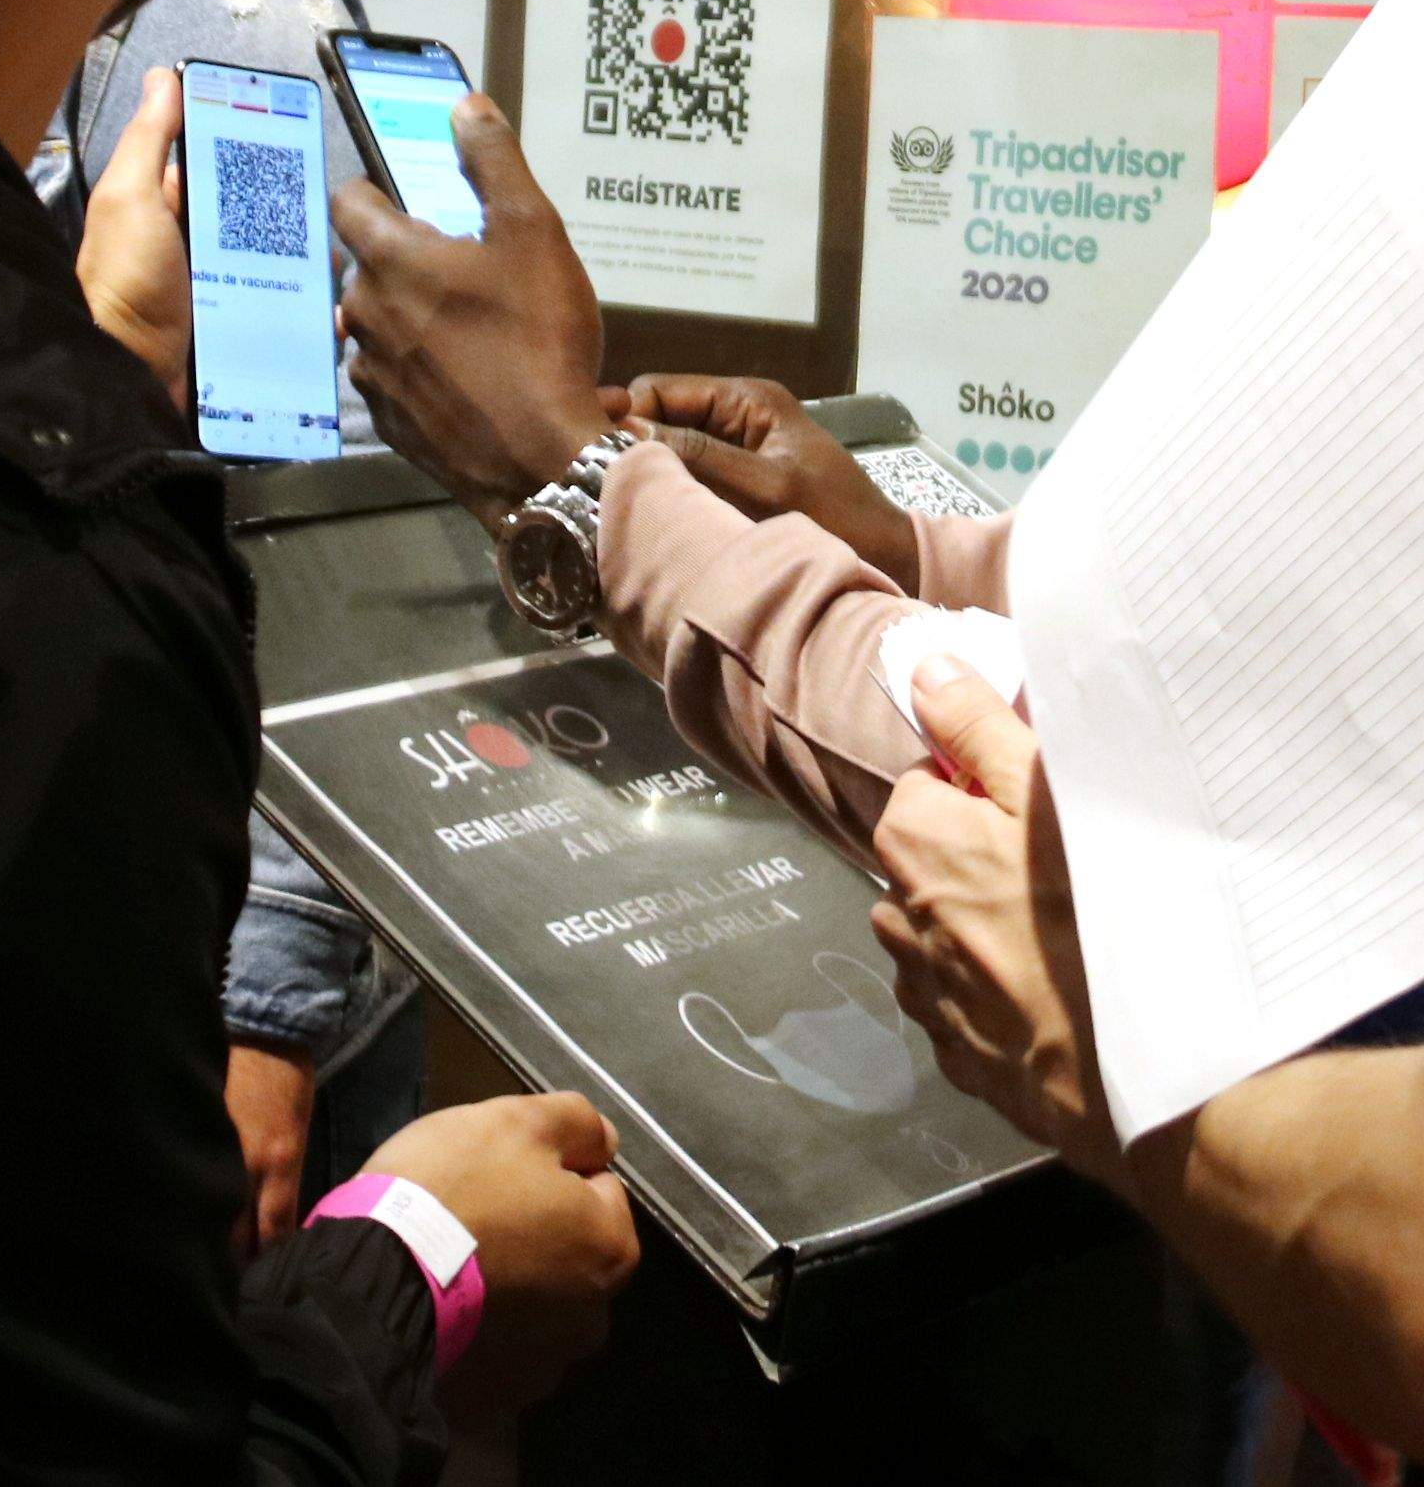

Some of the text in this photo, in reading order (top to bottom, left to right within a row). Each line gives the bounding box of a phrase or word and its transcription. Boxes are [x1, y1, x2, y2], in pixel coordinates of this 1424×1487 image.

[969, 129, 1185, 179] Tripadvisor
[585, 174, 741, 212] REGÍSTRATE
[967, 174, 1163, 223] Travellers'
[964, 218, 1098, 264] Choice
[223, 272, 236, 285] de
[240, 275, 303, 293] vacunació:
[960, 270, 1049, 304] 2020
[958, 381, 1055, 422] Shôko
[435, 797, 584, 853] REMEMBE
[627, 765, 716, 801] WEAR
[545, 856, 805, 947] RECUERDA LLEVAR
[623, 899, 801, 967] MASCARILLA
